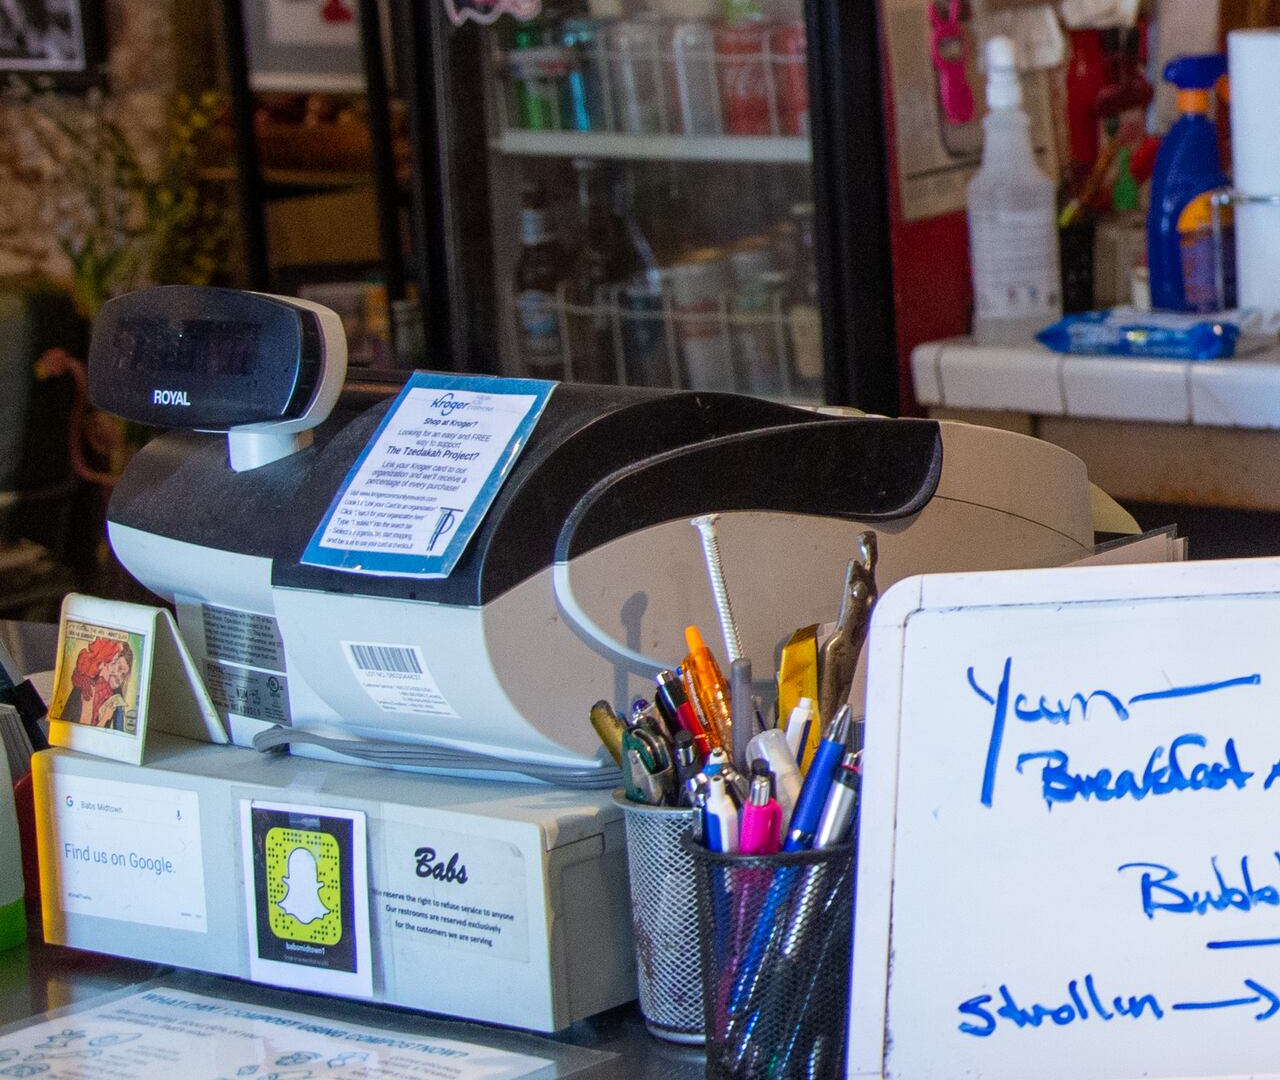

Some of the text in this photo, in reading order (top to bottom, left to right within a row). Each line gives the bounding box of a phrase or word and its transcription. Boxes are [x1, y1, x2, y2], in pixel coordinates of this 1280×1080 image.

[153, 389, 191, 406] ROYAL
[430, 392, 470, 416] Kroger
[423, 417, 440, 426] Shop
[450, 420, 478, 429] Kroger?
[398, 429, 422, 439] Looking
[422, 430, 432, 438] for
[441, 433, 456, 441] easy
[472, 433, 493, 442] FREE
[386, 446, 480, 462] The Tzedakah Project?
[437, 441, 461, 450] support
[371, 470, 409, 478] organization
[395, 462, 409, 470] your
[410, 463, 432, 473] Kroger
[432, 464, 447, 472] card
[365, 478, 401, 488] percentage
[408, 481, 427, 490] every
[1016, 733, 1255, 813] Breakfast
[81, 800, 123, 814] Babs Midtown
[64, 842, 176, 876] Find us on Google.
[414, 847, 468, 884] Babs
[383, 891, 405, 900] reserve
[406, 893, 416, 902] the
[418, 896, 432, 906] right
[432, 899, 440, 907] to
[441, 901, 460, 911] refuse
[461, 905, 482, 915] service
[483, 908, 490, 917] to
[491, 911, 515, 921] anyone
[385, 904, 501, 934] Our restrooms are reserved exclusively
[395, 920, 493, 948] for the customers we are serving
[142, 992, 188, 1007] WHAT
[184, 1002, 218, 1013] CAN
[223, 1008, 299, 1028] COMPOST
[297, 1023, 348, 1039] USING
[345, 1032, 470, 1058] COMPOSTNOW?
